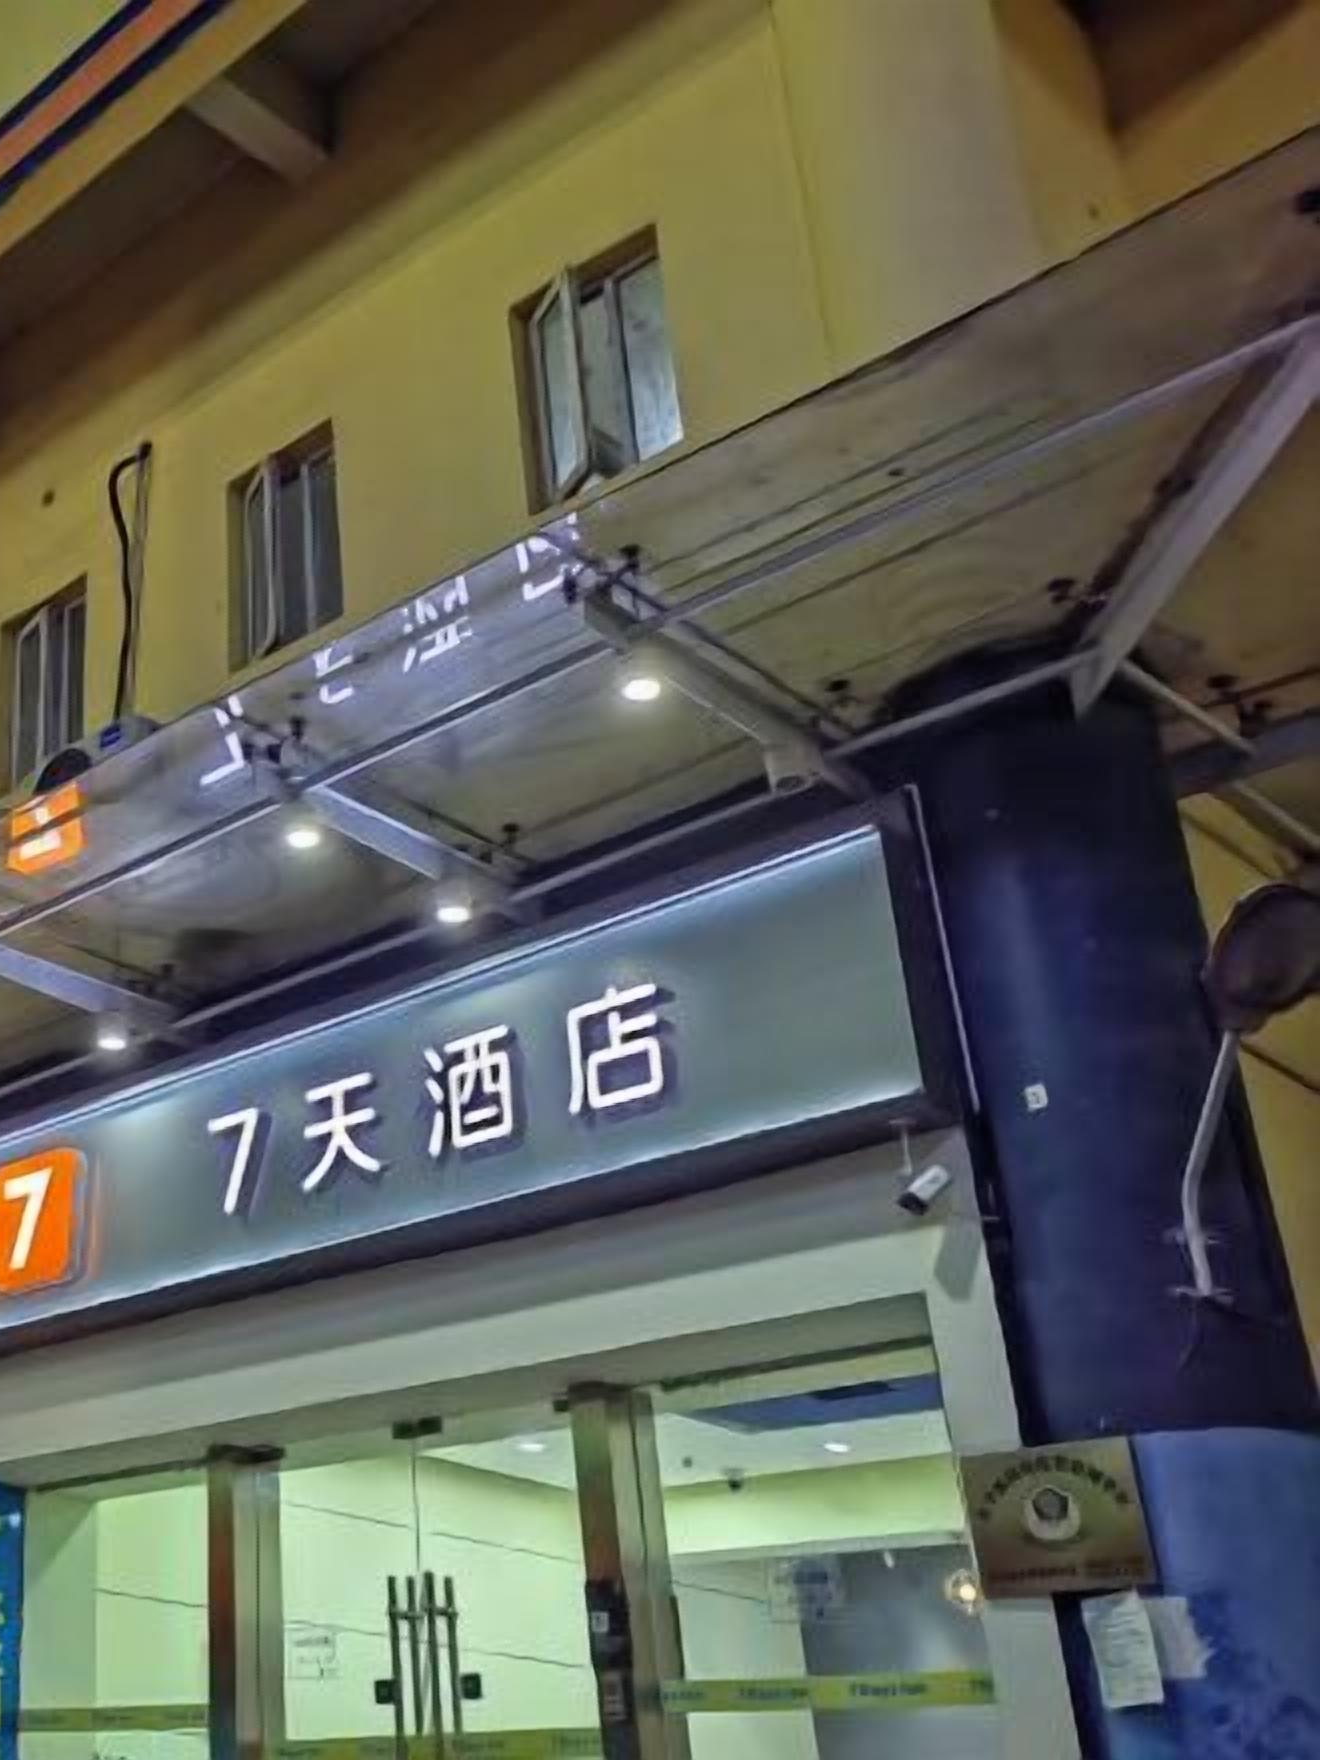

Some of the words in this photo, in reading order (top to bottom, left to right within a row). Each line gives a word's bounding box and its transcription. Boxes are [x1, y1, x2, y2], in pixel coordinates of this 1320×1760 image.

[207, 982, 665, 1215] 7天酒店
[3, 1167, 54, 1270] 7
